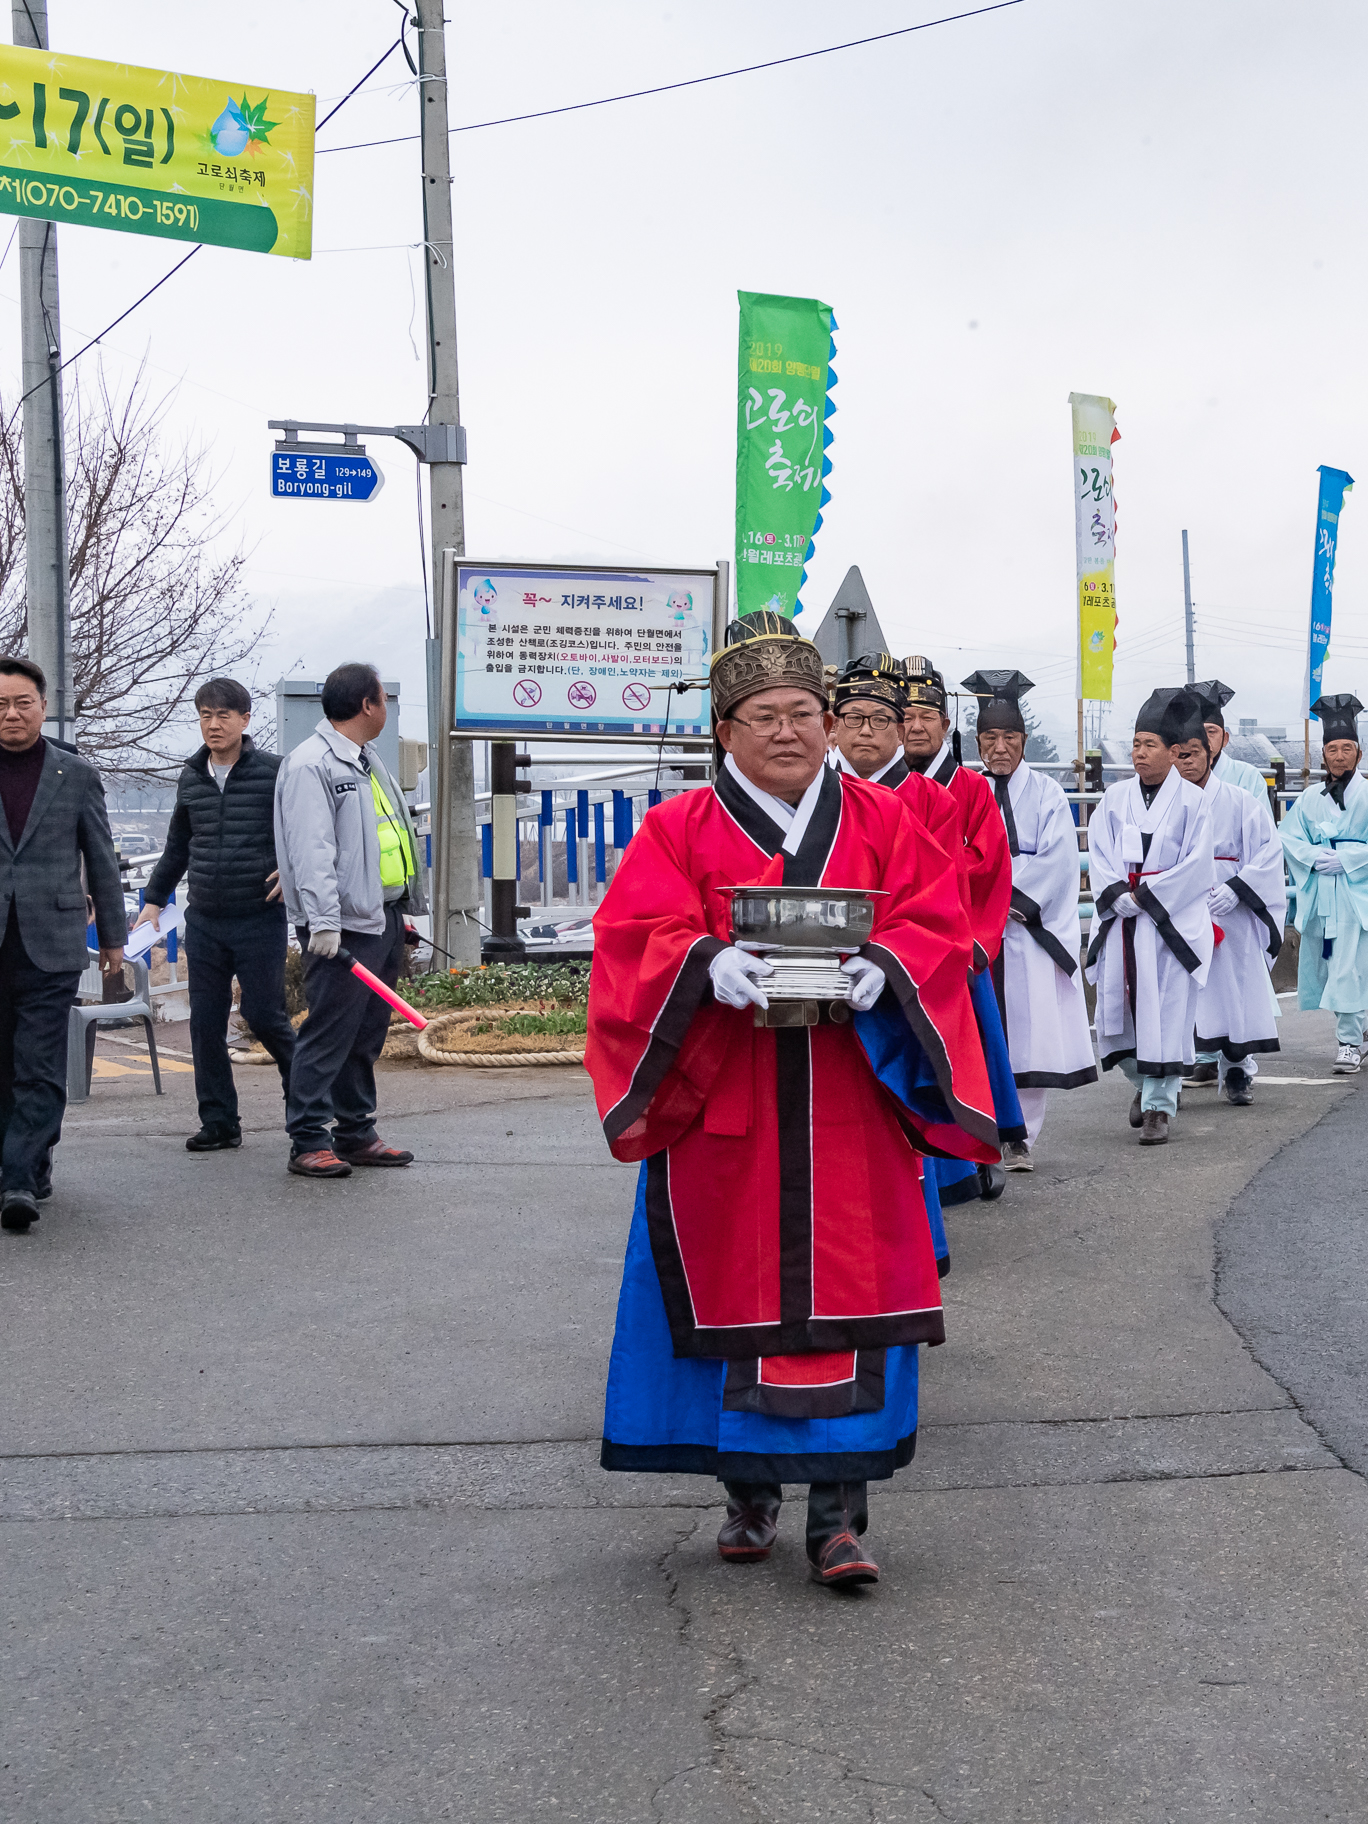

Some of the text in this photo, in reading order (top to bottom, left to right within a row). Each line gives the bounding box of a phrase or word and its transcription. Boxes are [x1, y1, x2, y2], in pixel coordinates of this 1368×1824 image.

[197, 162, 266, 187] 고로쇠축제
[277, 458, 325, 479] 보룡길
[277, 479, 352, 497] Boryong-gil
[743, 532, 762, 545] .16
[523, 593, 643, 611] 꼭~ 지켜주세요!
[488, 624, 682, 639] 본 시설은 군민 체력증진을 위하여 단월면에서
[487, 638, 682, 652] 조성한 산책로(조깅코스)입니다. 주민의 안전을
[487, 650, 514, 660] 위하여
[486, 663, 513, 673] 출입을
[661, 669, 683, 678] 제외)
